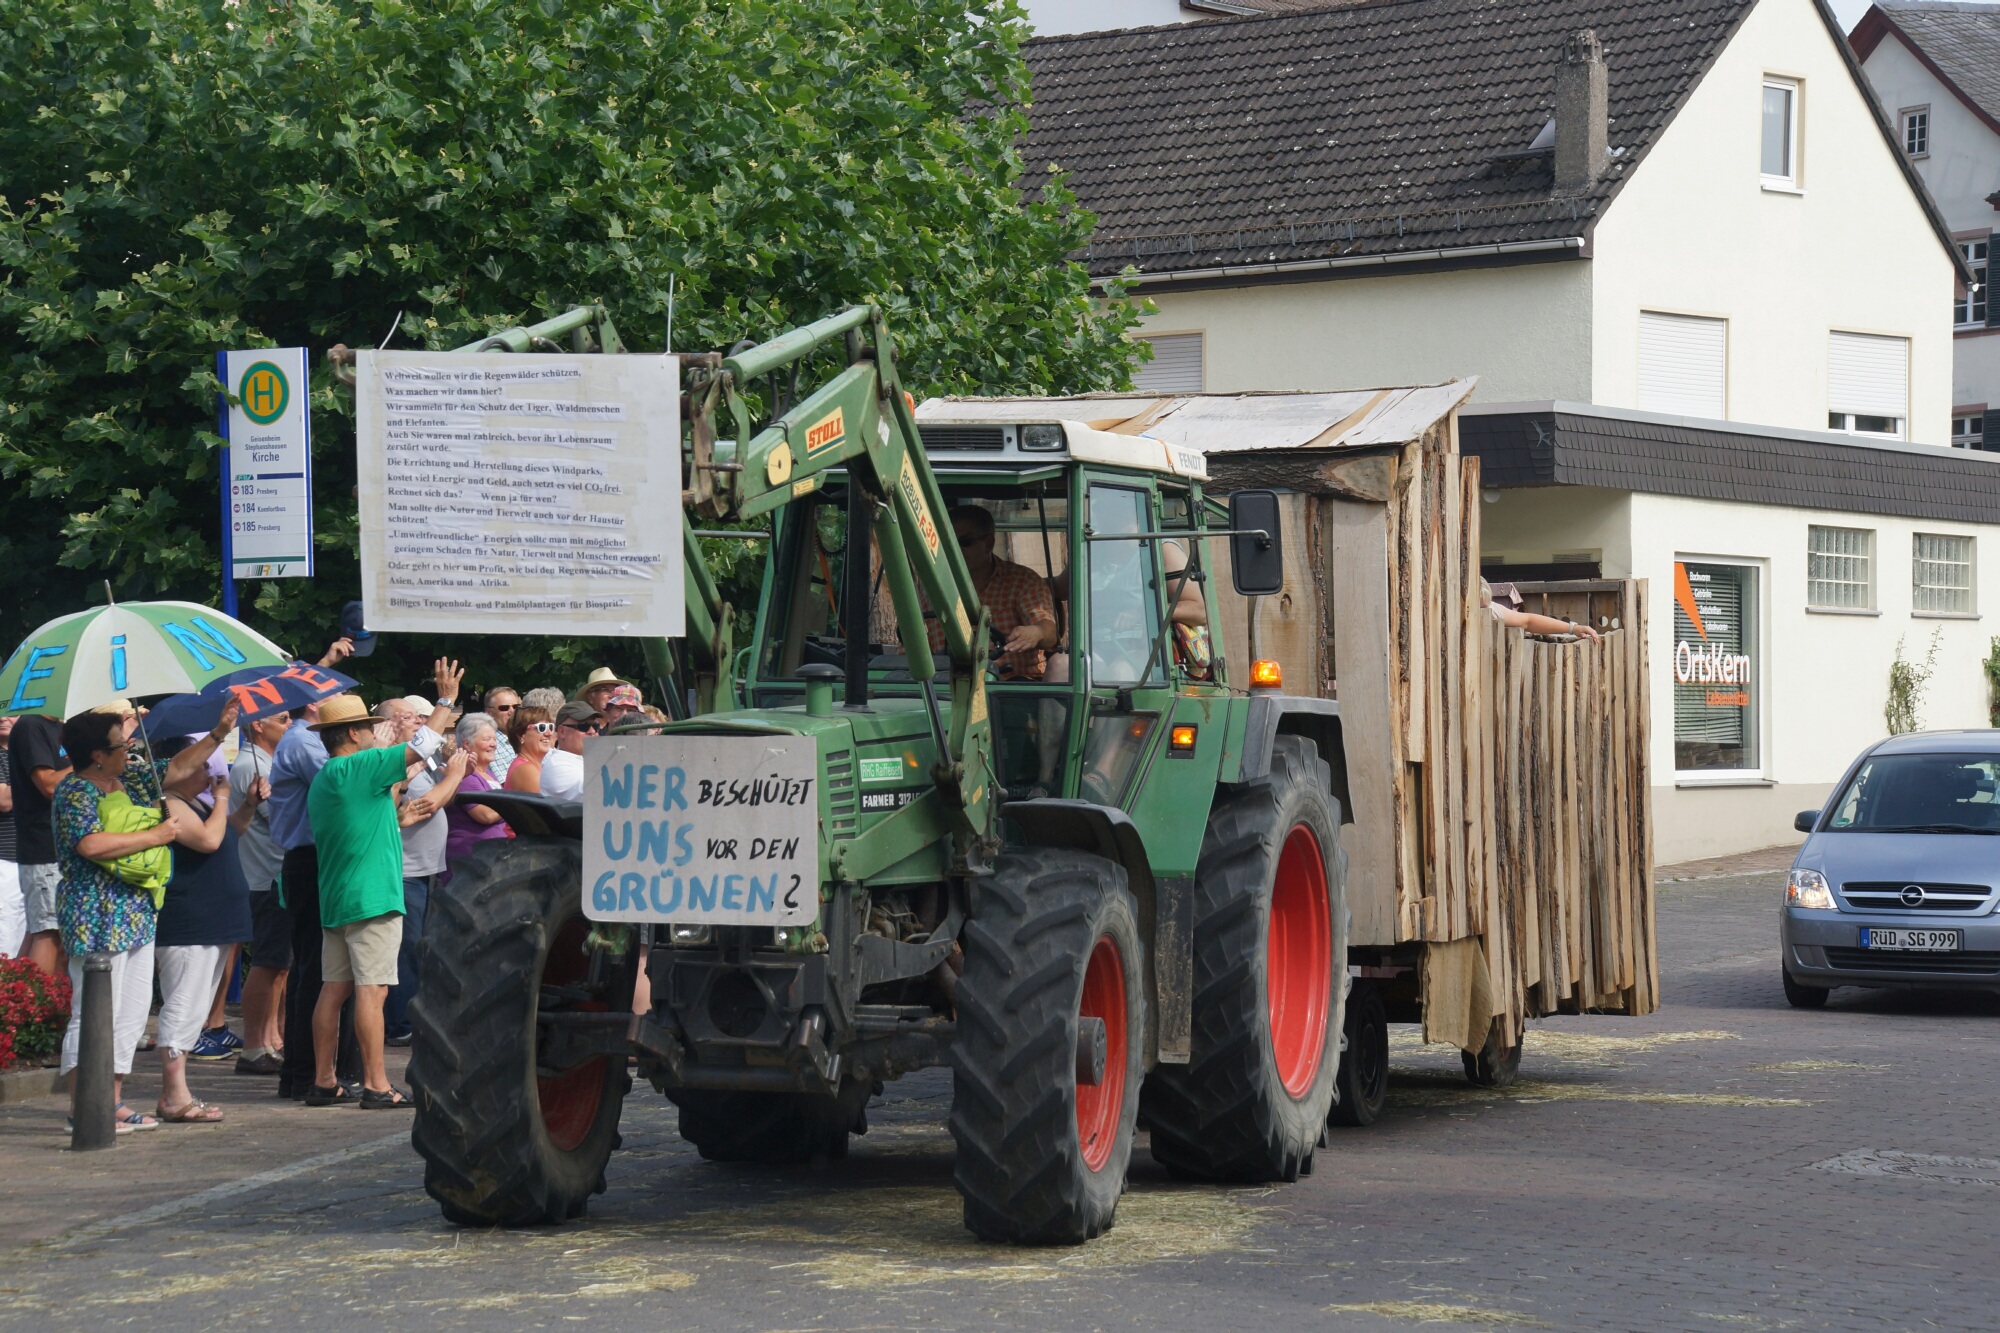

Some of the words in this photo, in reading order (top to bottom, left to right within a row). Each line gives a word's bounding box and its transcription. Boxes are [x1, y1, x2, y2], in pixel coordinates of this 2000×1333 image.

[385, 372, 421, 380] Weltweit
[424, 372, 451, 380] wollen
[470, 372, 481, 380] die
[485, 371, 539, 381] Regenwälder
[253, 376, 274, 410] H
[445, 403, 458, 411] für
[461, 403, 475, 411] den
[556, 404, 620, 413] Waldmenschen
[473, 433, 515, 441] zahlreich,
[518, 434, 541, 442] bevor
[559, 435, 612, 444] Lebensraum
[808, 417, 843, 449] STOLL
[422, 444, 451, 452] wurde.
[253, 452, 280, 462] Kirche
[1178, 452, 1201, 470] FENDT
[404, 458, 450, 468] Errichtung
[453, 460, 469, 468] und
[473, 461, 522, 472] Herstellung
[525, 464, 549, 472] dieses
[552, 466, 603, 476] Windparks,
[241, 485, 254, 495] 183
[388, 473, 412, 481] kostet
[415, 474, 429, 482] viel
[432, 475, 465, 484] Energie
[468, 477, 484, 485] und
[487, 478, 510, 487] Geld,
[512, 480, 532, 488] auch
[605, 484, 621, 493] frei.
[388, 488, 422, 496] Rechnet
[425, 489, 440, 497] sich
[444, 490, 463, 498] das?
[481, 493, 506, 501] Wenn
[509, 494, 517, 503] ja
[535, 495, 556, 503] wen?
[902, 468, 923, 514] ROBUST
[242, 503, 256, 513] 184
[389, 503, 407, 511] Man
[410, 504, 432, 512] sollte
[450, 505, 474, 513] Natur
[496, 509, 531, 518] Tierwelt
[573, 514, 587, 522] der
[590, 515, 624, 525] Haustür
[242, 521, 256, 532] 185
[258, 524, 281, 532] Presberg
[388, 516, 428, 524] schützen!
[484, 535, 522, 544] Energien
[570, 536, 583, 545] mit
[586, 537, 626, 547] möglichst
[395, 545, 433, 553] geringem
[436, 546, 471, 554] Schaden
[522, 550, 556, 558] Tierwelt
[558, 550, 573, 559] und
[576, 552, 618, 561] Menschen
[621, 554, 660, 563] erzeugen!
[388, 562, 409, 570] Oder
[412, 563, 430, 572] geht
[444, 563, 460, 571] hier
[479, 565, 506, 573] Profit,
[525, 564, 537, 574] bei
[540, 566, 555, 574] den
[389, 577, 414, 585] Asien,
[479, 579, 509, 587] Afrika.
[390, 598, 420, 607] Billiges
[423, 599, 472, 608] Tropenholz
[476, 600, 492, 609] und
[570, 601, 583, 609] für
[586, 599, 623, 609] Biosprit?
[1676, 640, 1750, 684] OrtsKern
[601, 763, 688, 812] WER
[698, 773, 814, 806] BESCHÜTZT
[862, 793, 895, 808] FARMER
[603, 820, 695, 867] UNS
[706, 838, 737, 860] VOR
[750, 837, 799, 860] DEN
[1870, 931, 1896, 946] RÜD
[1908, 932, 1925, 946] SG
[1929, 933, 1955, 947] 999
